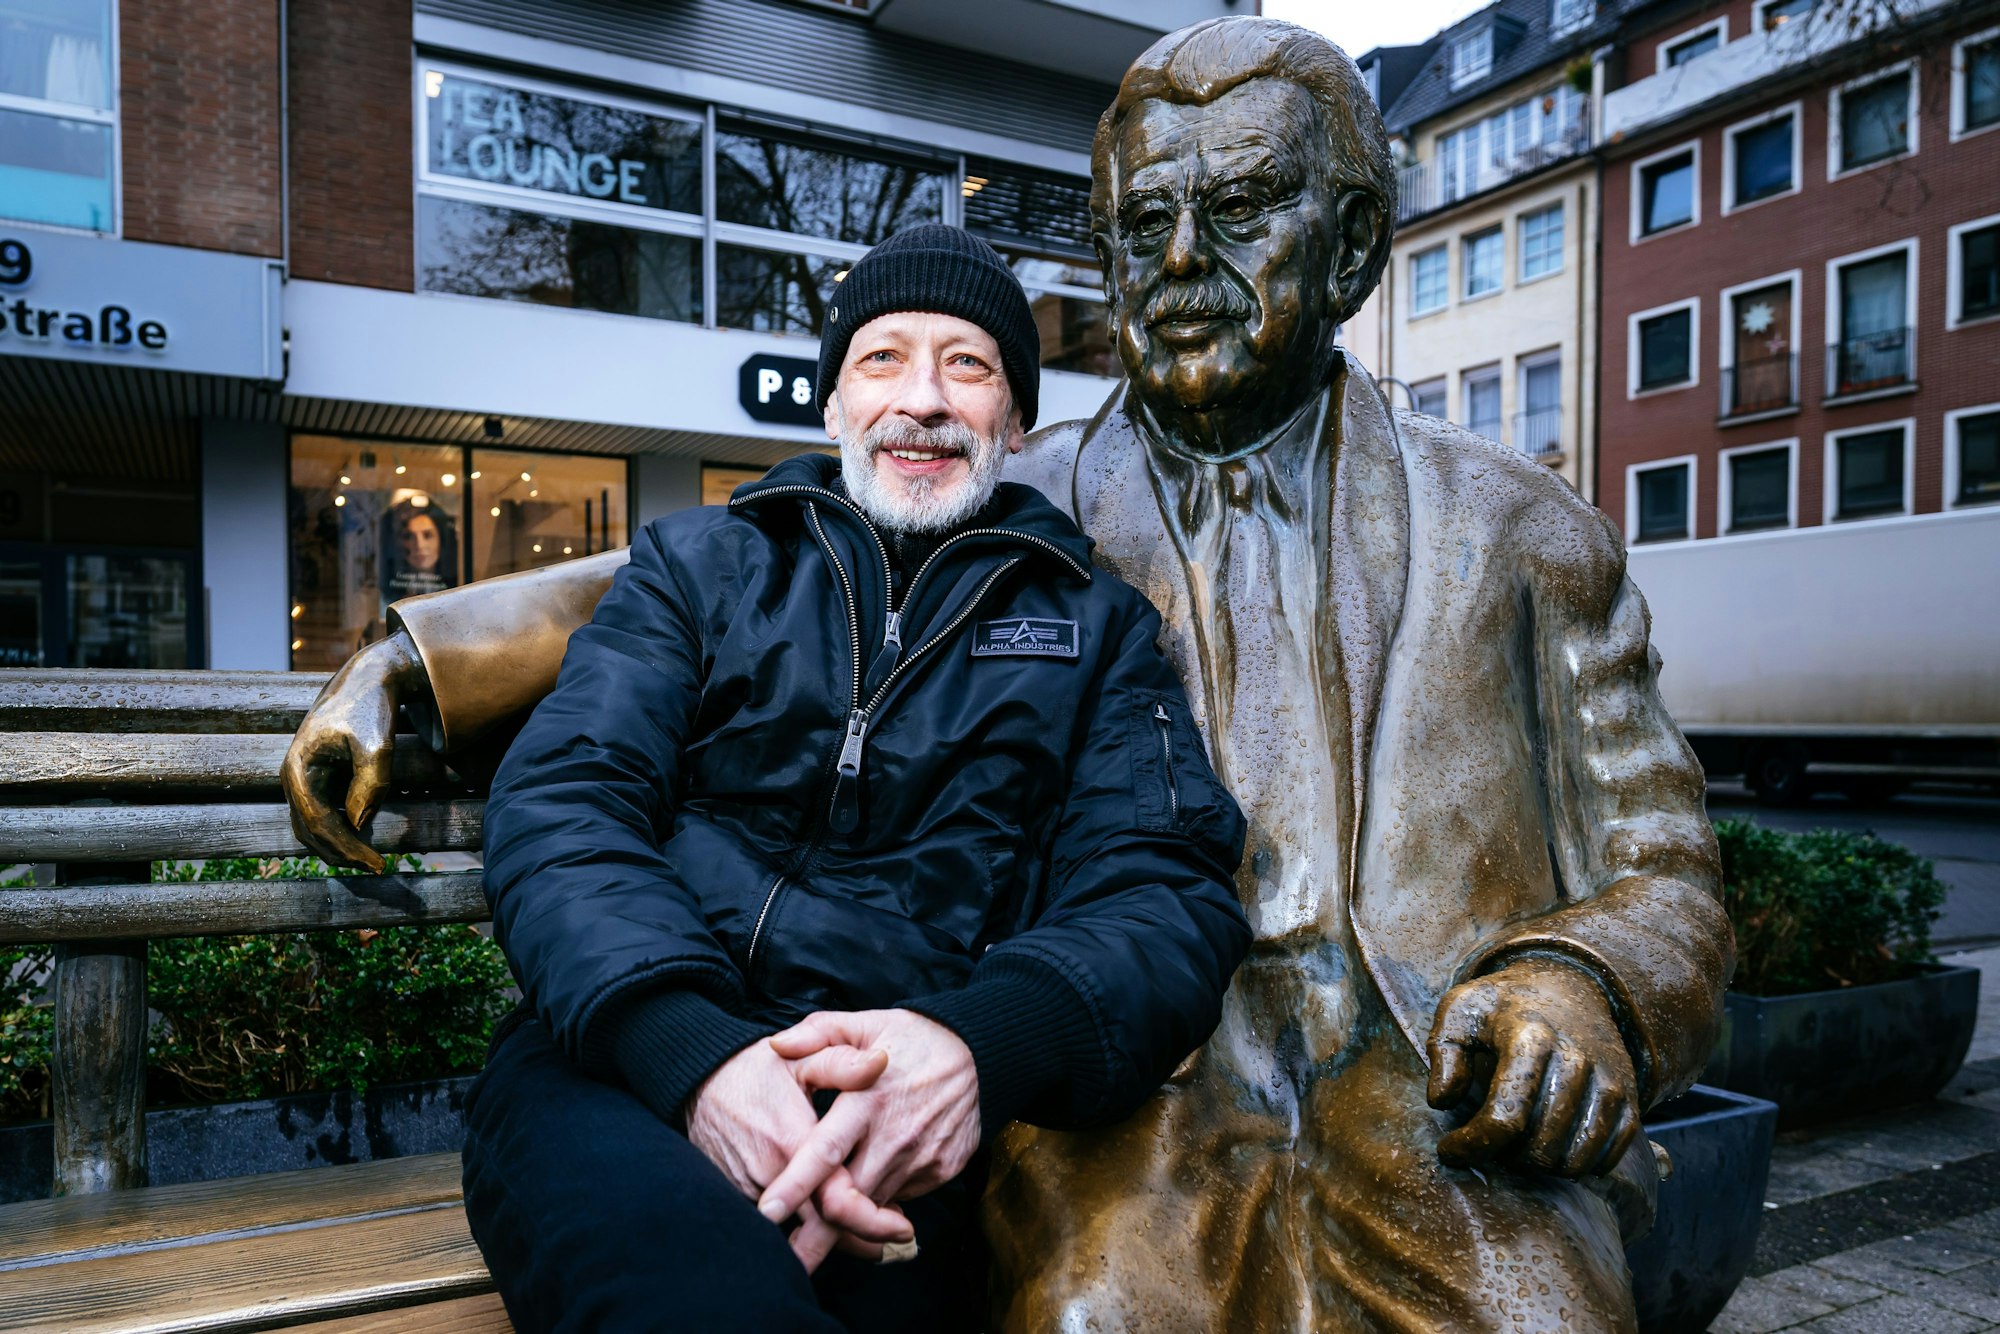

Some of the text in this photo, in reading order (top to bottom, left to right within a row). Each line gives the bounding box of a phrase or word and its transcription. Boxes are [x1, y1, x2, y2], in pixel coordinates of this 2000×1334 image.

[439, 83, 525, 135] TEA
[442, 129, 647, 203] LOUNGE
[0, 297, 167, 349] traße
[758, 368, 783, 404] P
[978, 642, 1071, 652] ALPHA INDUSTRIES
